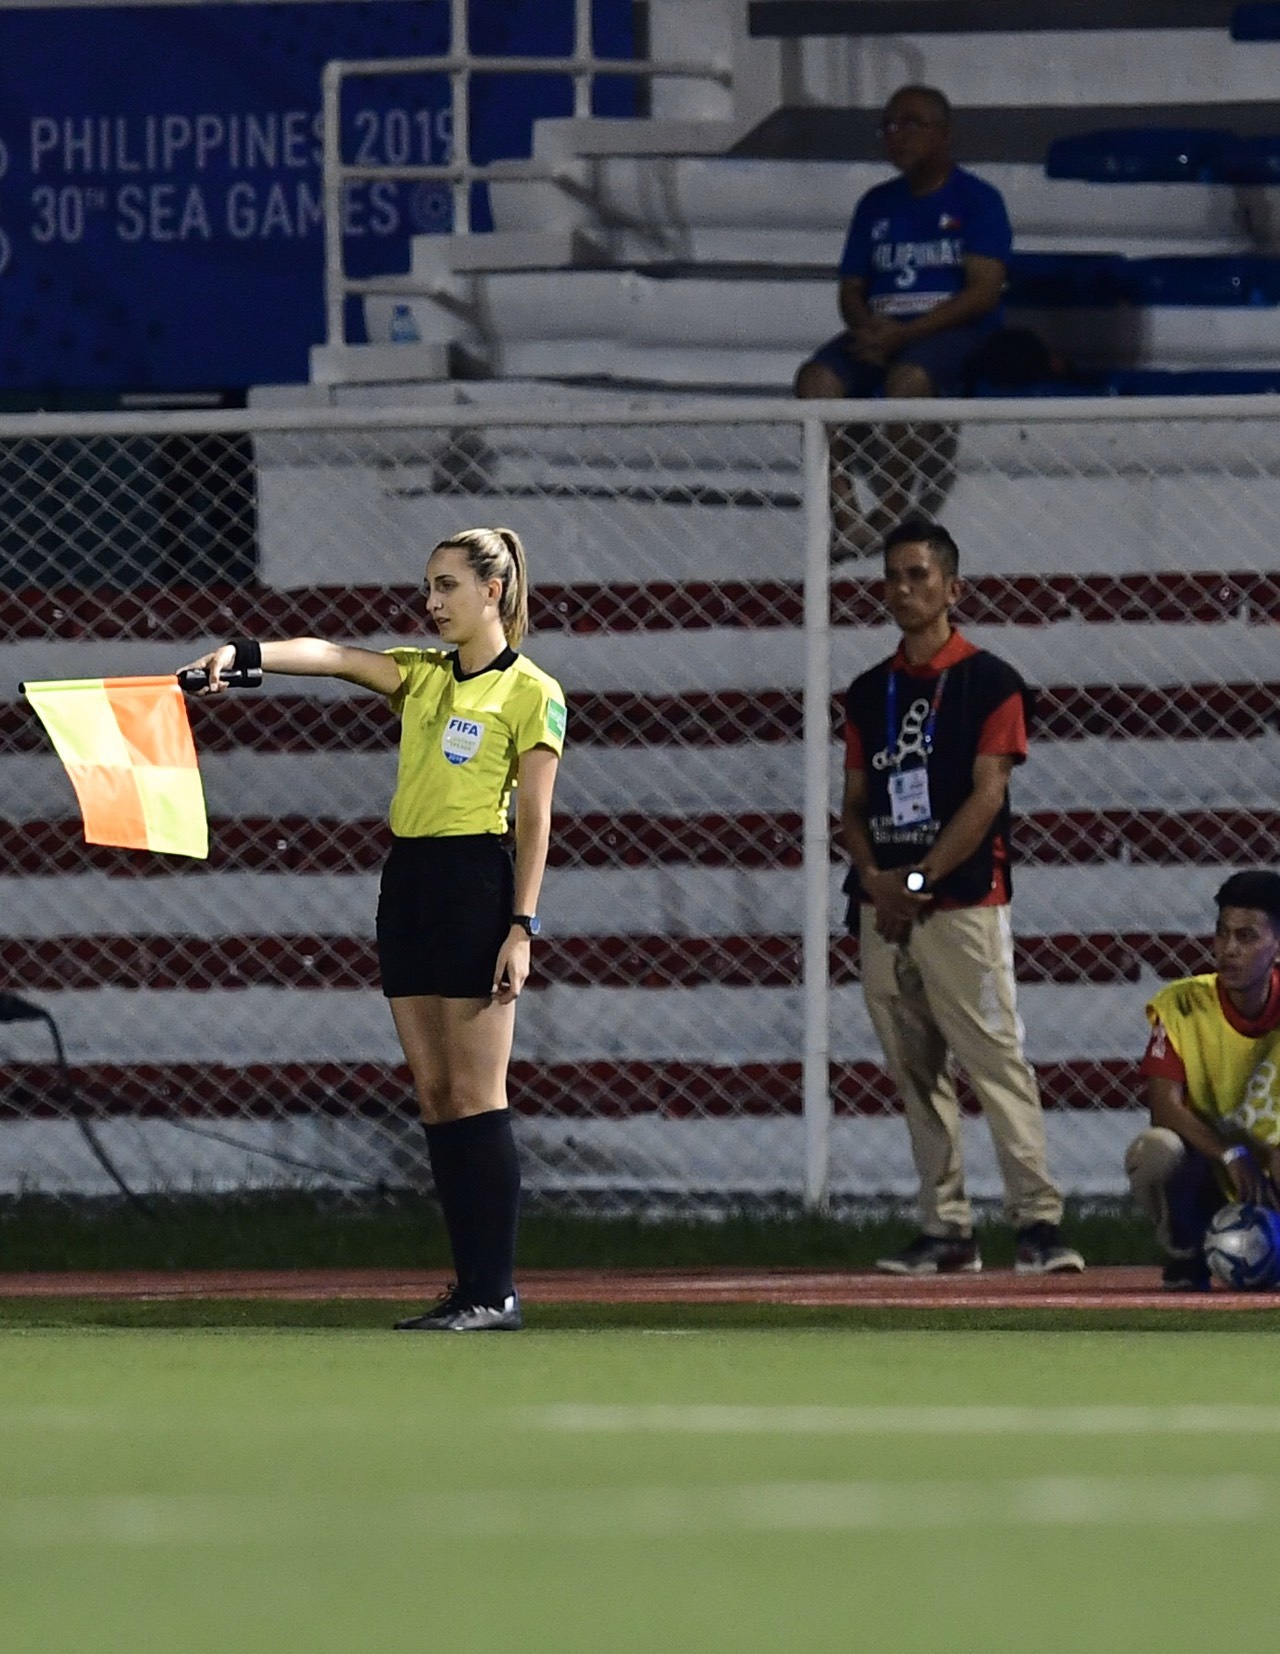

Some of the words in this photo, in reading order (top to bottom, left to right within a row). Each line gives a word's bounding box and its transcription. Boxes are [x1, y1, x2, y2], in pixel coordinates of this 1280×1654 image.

[117, 184, 210, 241] SEA
[226, 180, 400, 237] GAMES
[449, 719, 478, 736] FIFA
